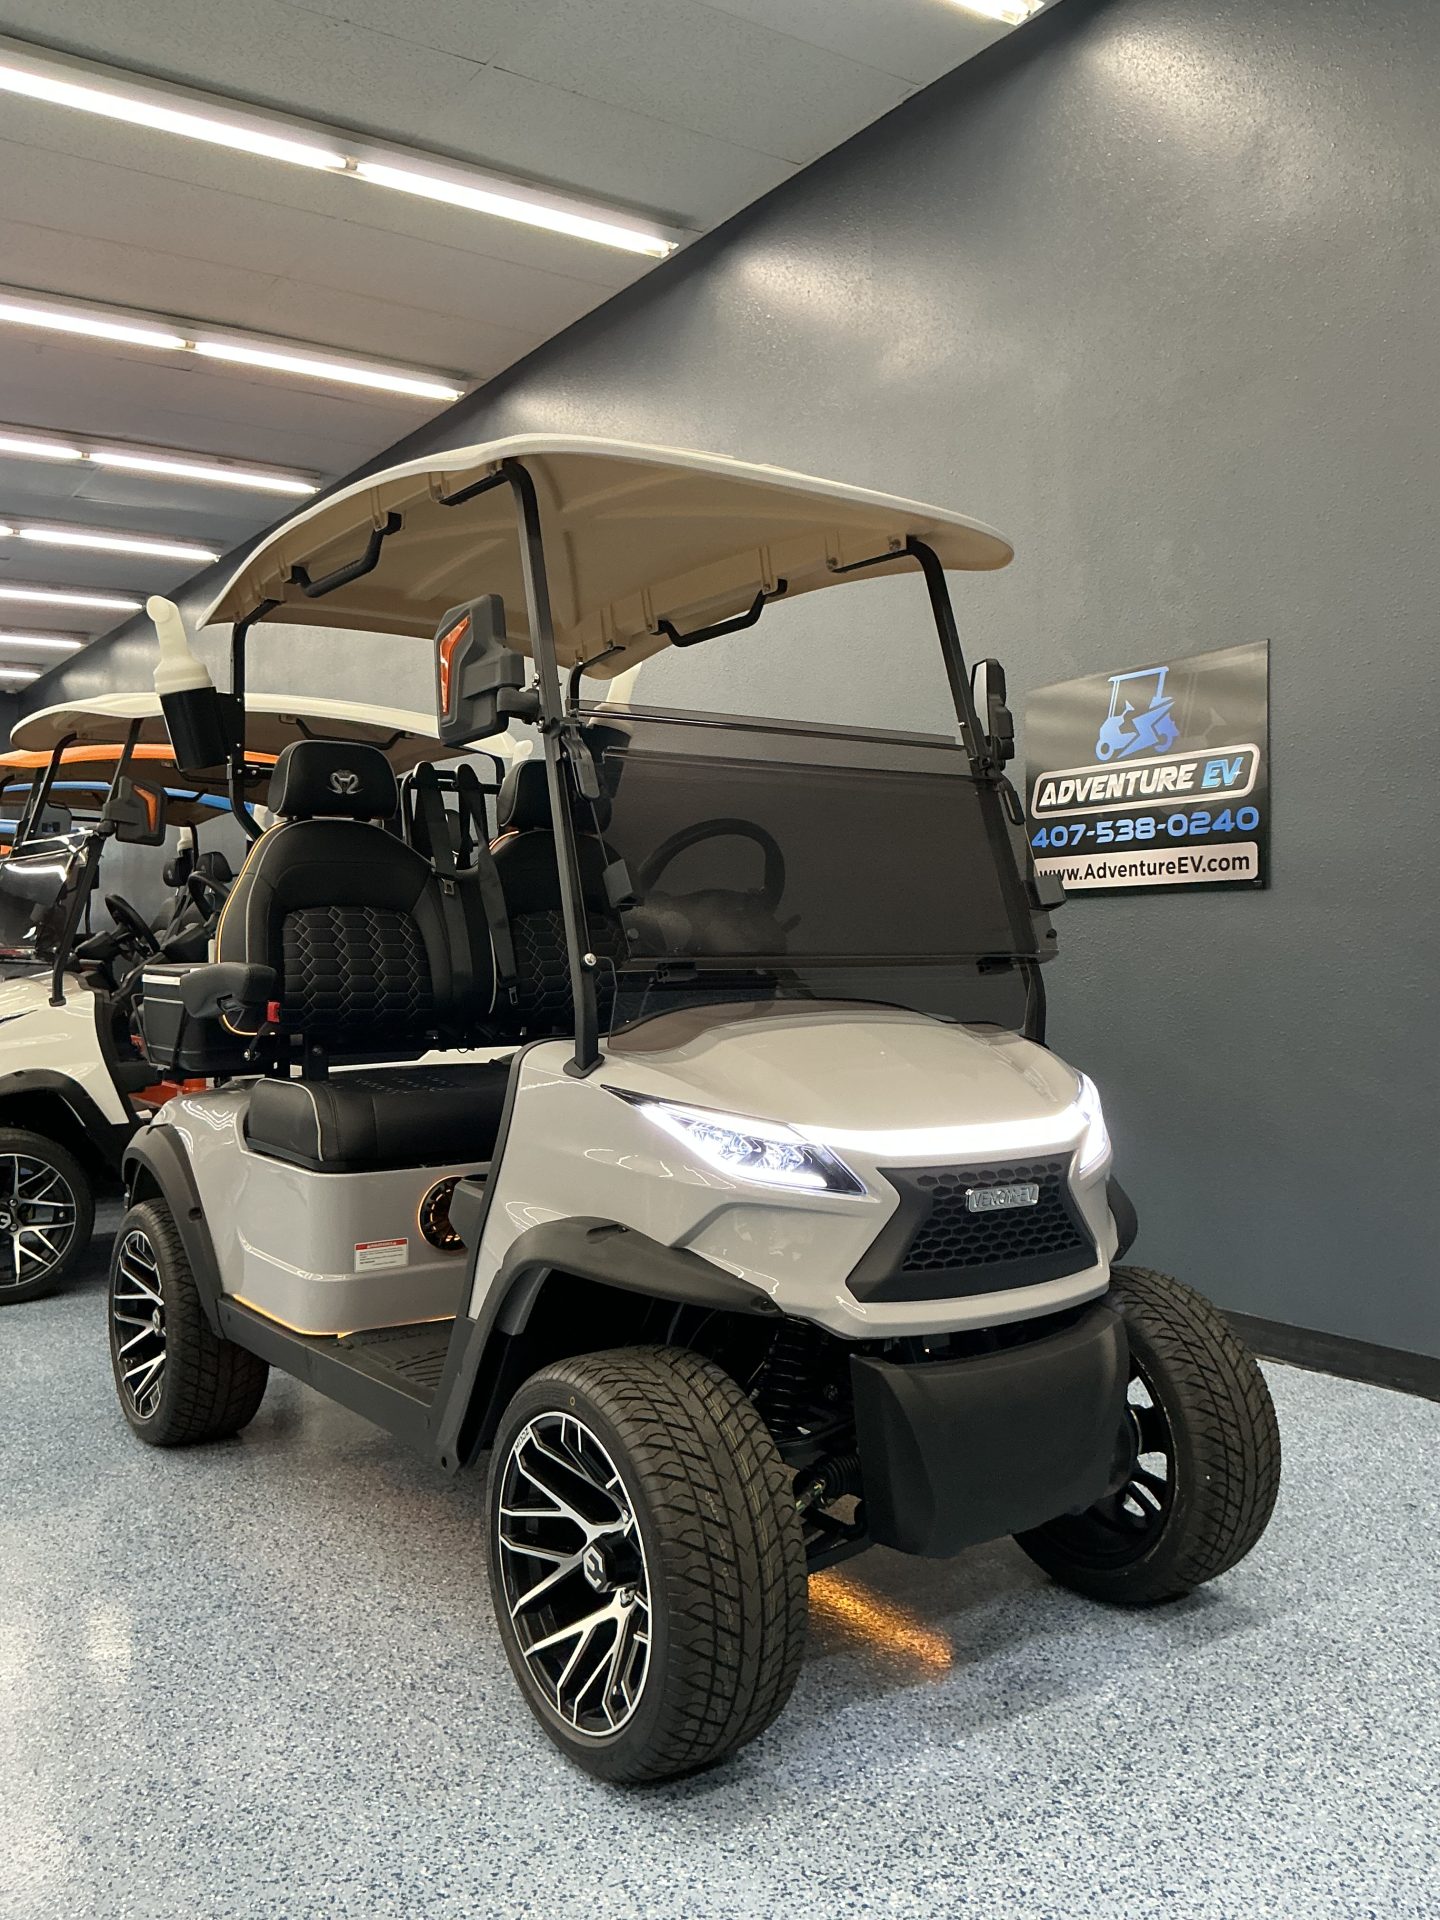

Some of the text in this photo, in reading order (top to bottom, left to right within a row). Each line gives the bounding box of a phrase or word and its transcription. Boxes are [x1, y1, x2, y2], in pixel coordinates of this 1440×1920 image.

[1038, 756, 1245, 807] ADVENTURE EV
[1031, 806, 1260, 848] 407-538-0240
